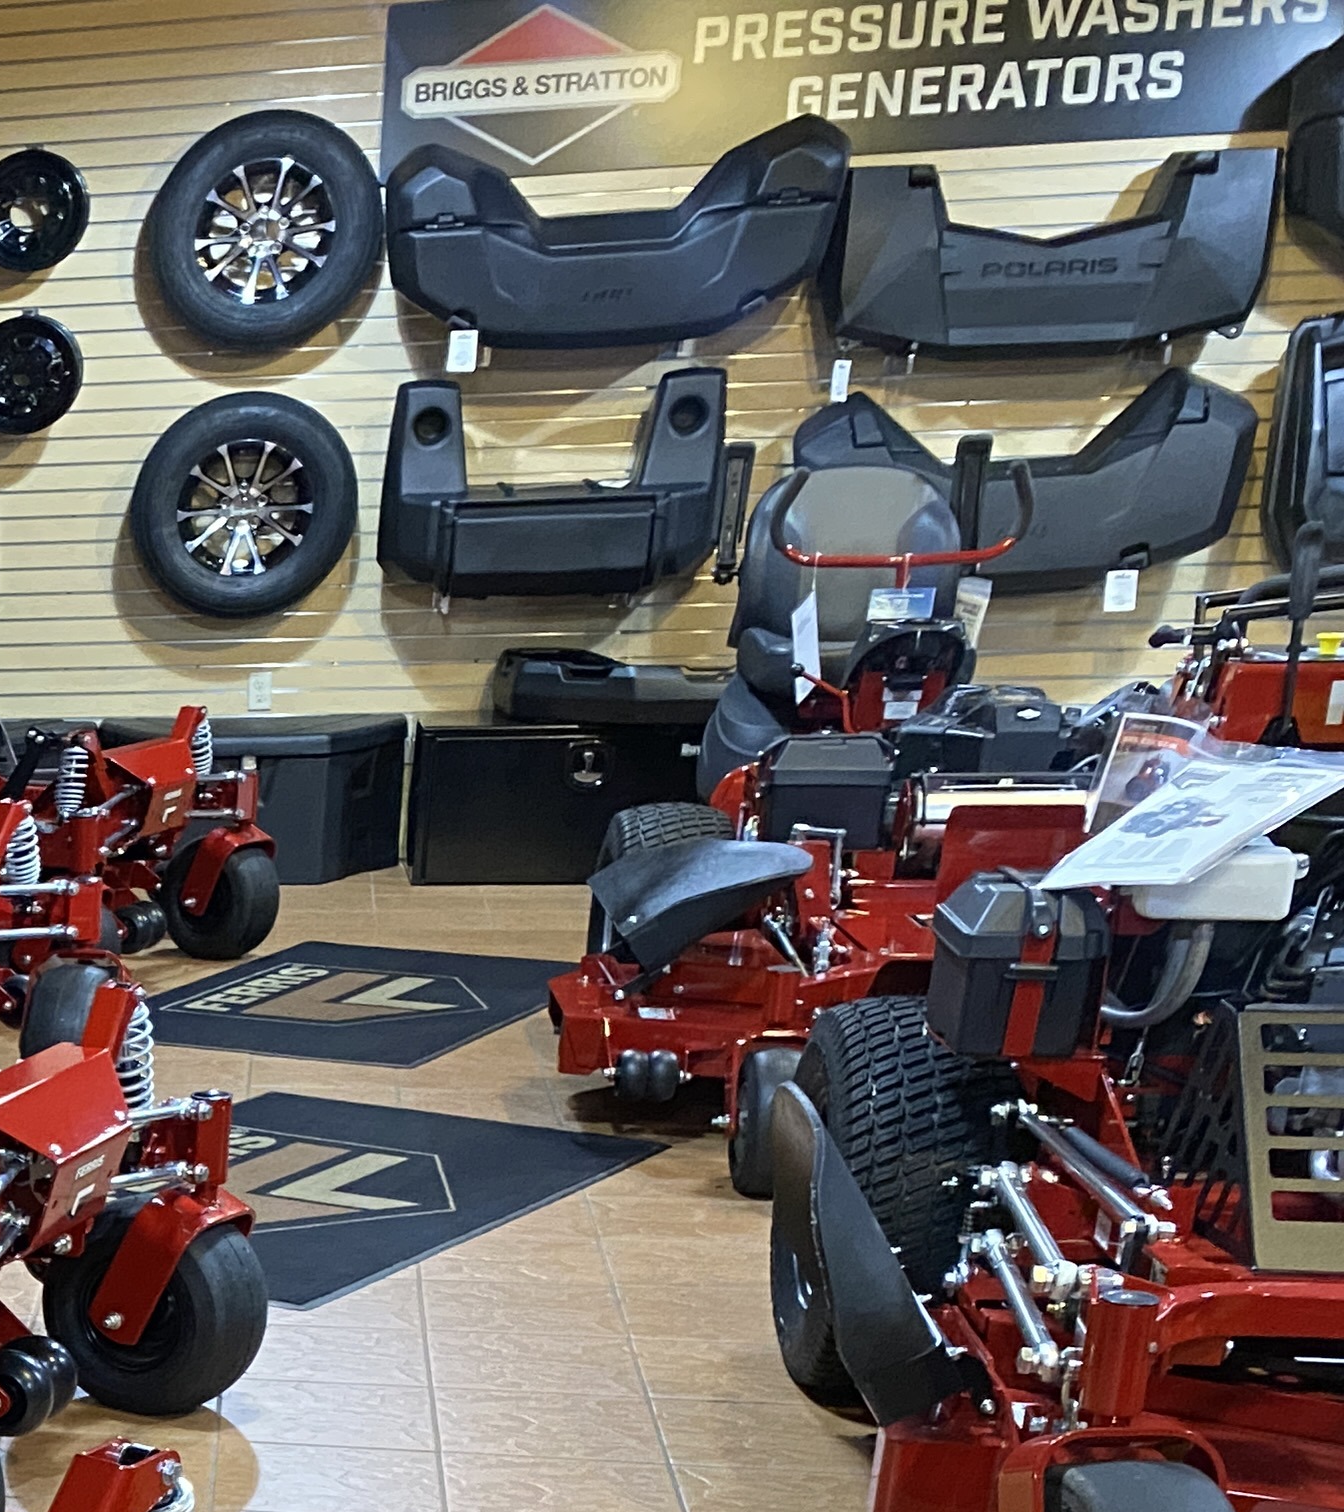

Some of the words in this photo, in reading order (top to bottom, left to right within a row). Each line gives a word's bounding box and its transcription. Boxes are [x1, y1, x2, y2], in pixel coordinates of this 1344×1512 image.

[693, 0, 1009, 63] PRESSURE
[414, 77, 507, 103] BRIGGS
[512, 75, 530, 96] &
[534, 65, 669, 95] STRATTON
[786, 50, 1185, 121] GENERATORS
[980, 256, 1119, 279] POLARIS
[183, 964, 330, 1013] FERRIS
